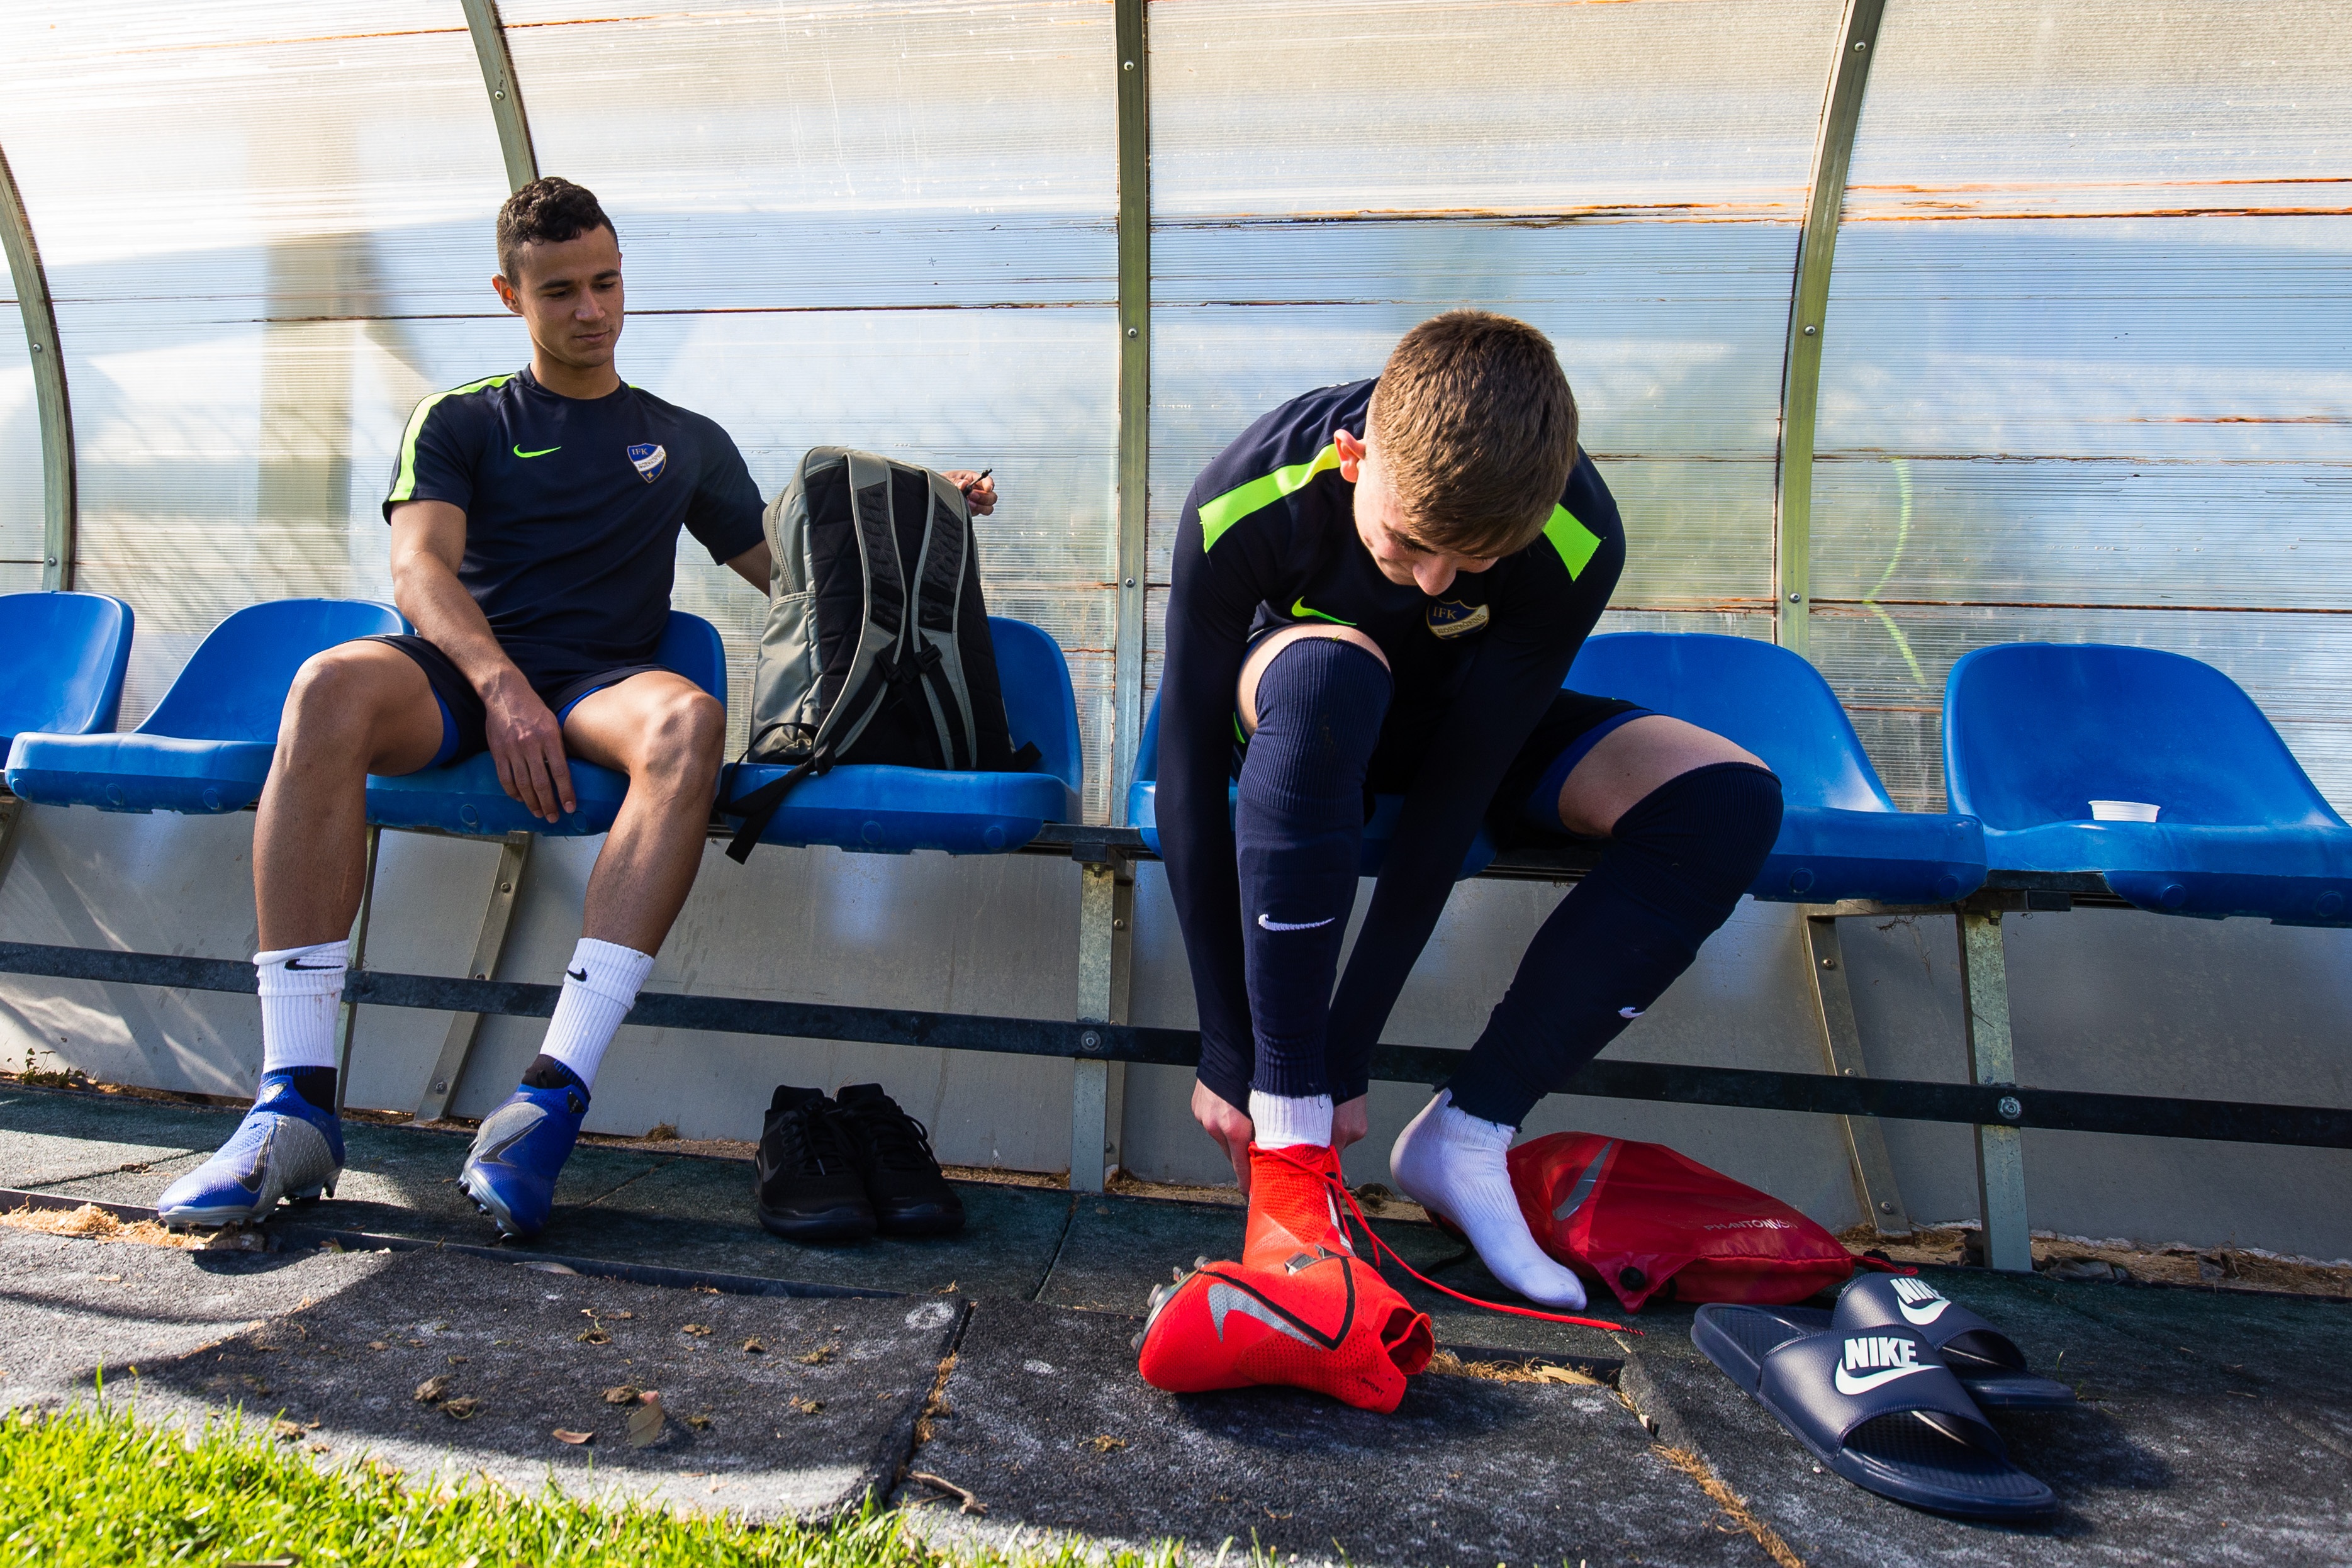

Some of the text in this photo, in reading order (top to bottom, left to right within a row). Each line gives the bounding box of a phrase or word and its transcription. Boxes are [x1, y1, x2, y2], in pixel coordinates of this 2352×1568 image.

[631, 447, 649, 456] IFK
[1433, 606, 1458, 620] IFK
[1436, 613, 1486, 634] NORRKÖPING
[1844, 1336, 1919, 1370] NIKE
